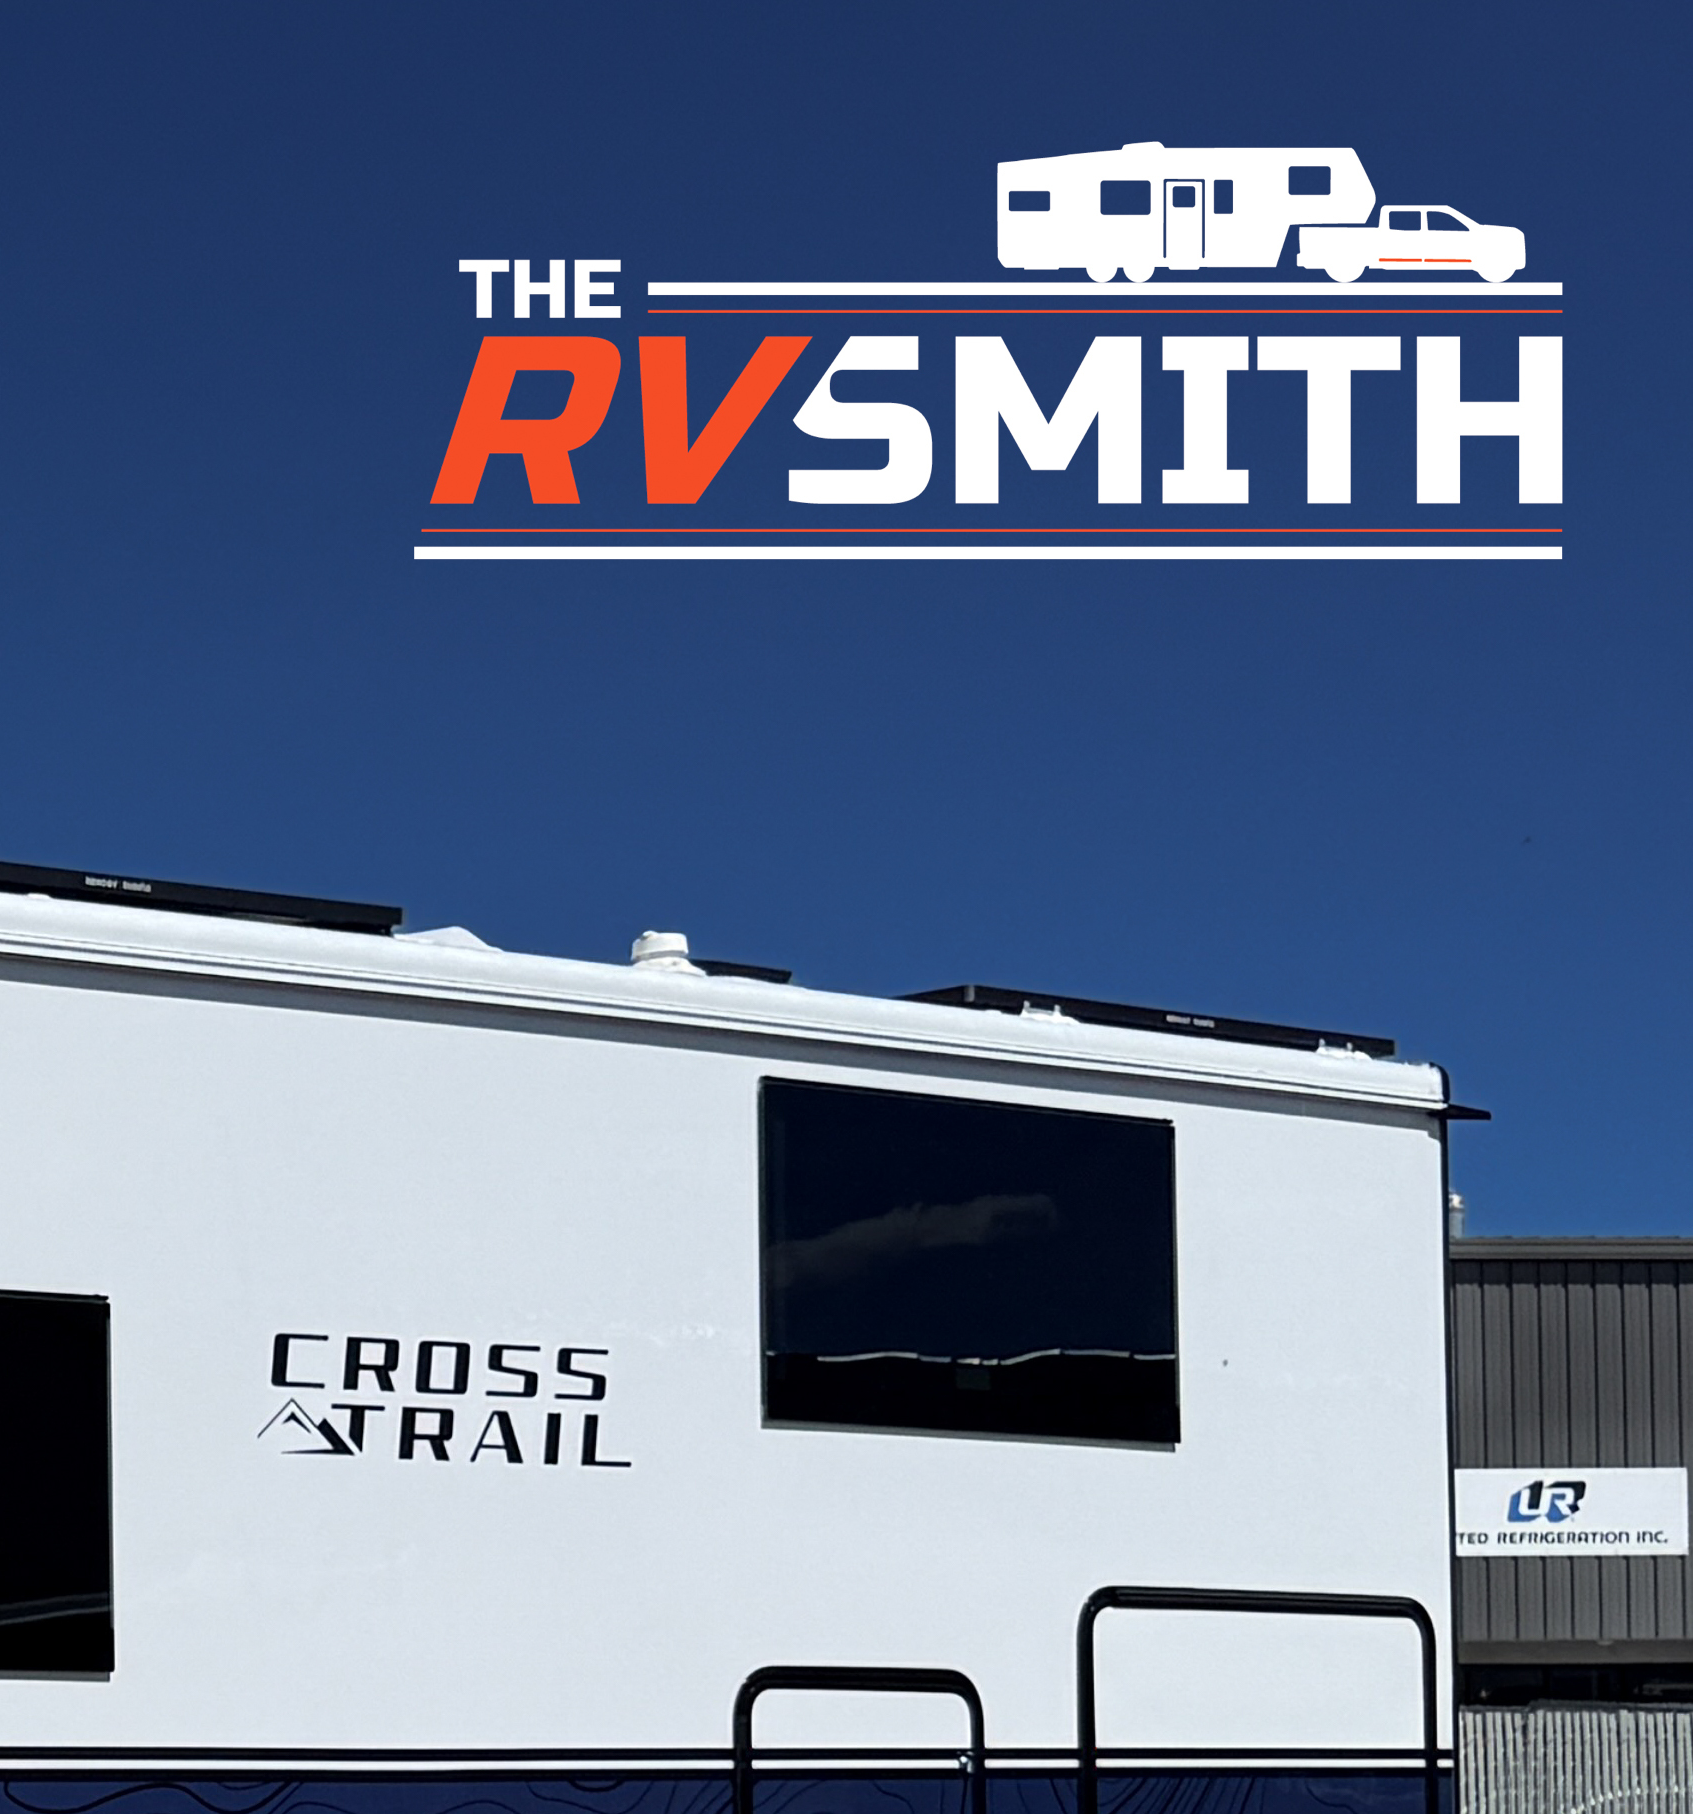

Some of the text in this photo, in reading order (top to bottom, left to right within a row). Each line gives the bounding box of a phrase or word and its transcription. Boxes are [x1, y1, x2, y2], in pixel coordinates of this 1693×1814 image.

[270, 1332, 610, 1401] CROSS
[330, 1403, 632, 1468] TRAIL
[1457, 1531, 1489, 1545] TED
[1497, 1531, 1631, 1545] REFRIGERATION
